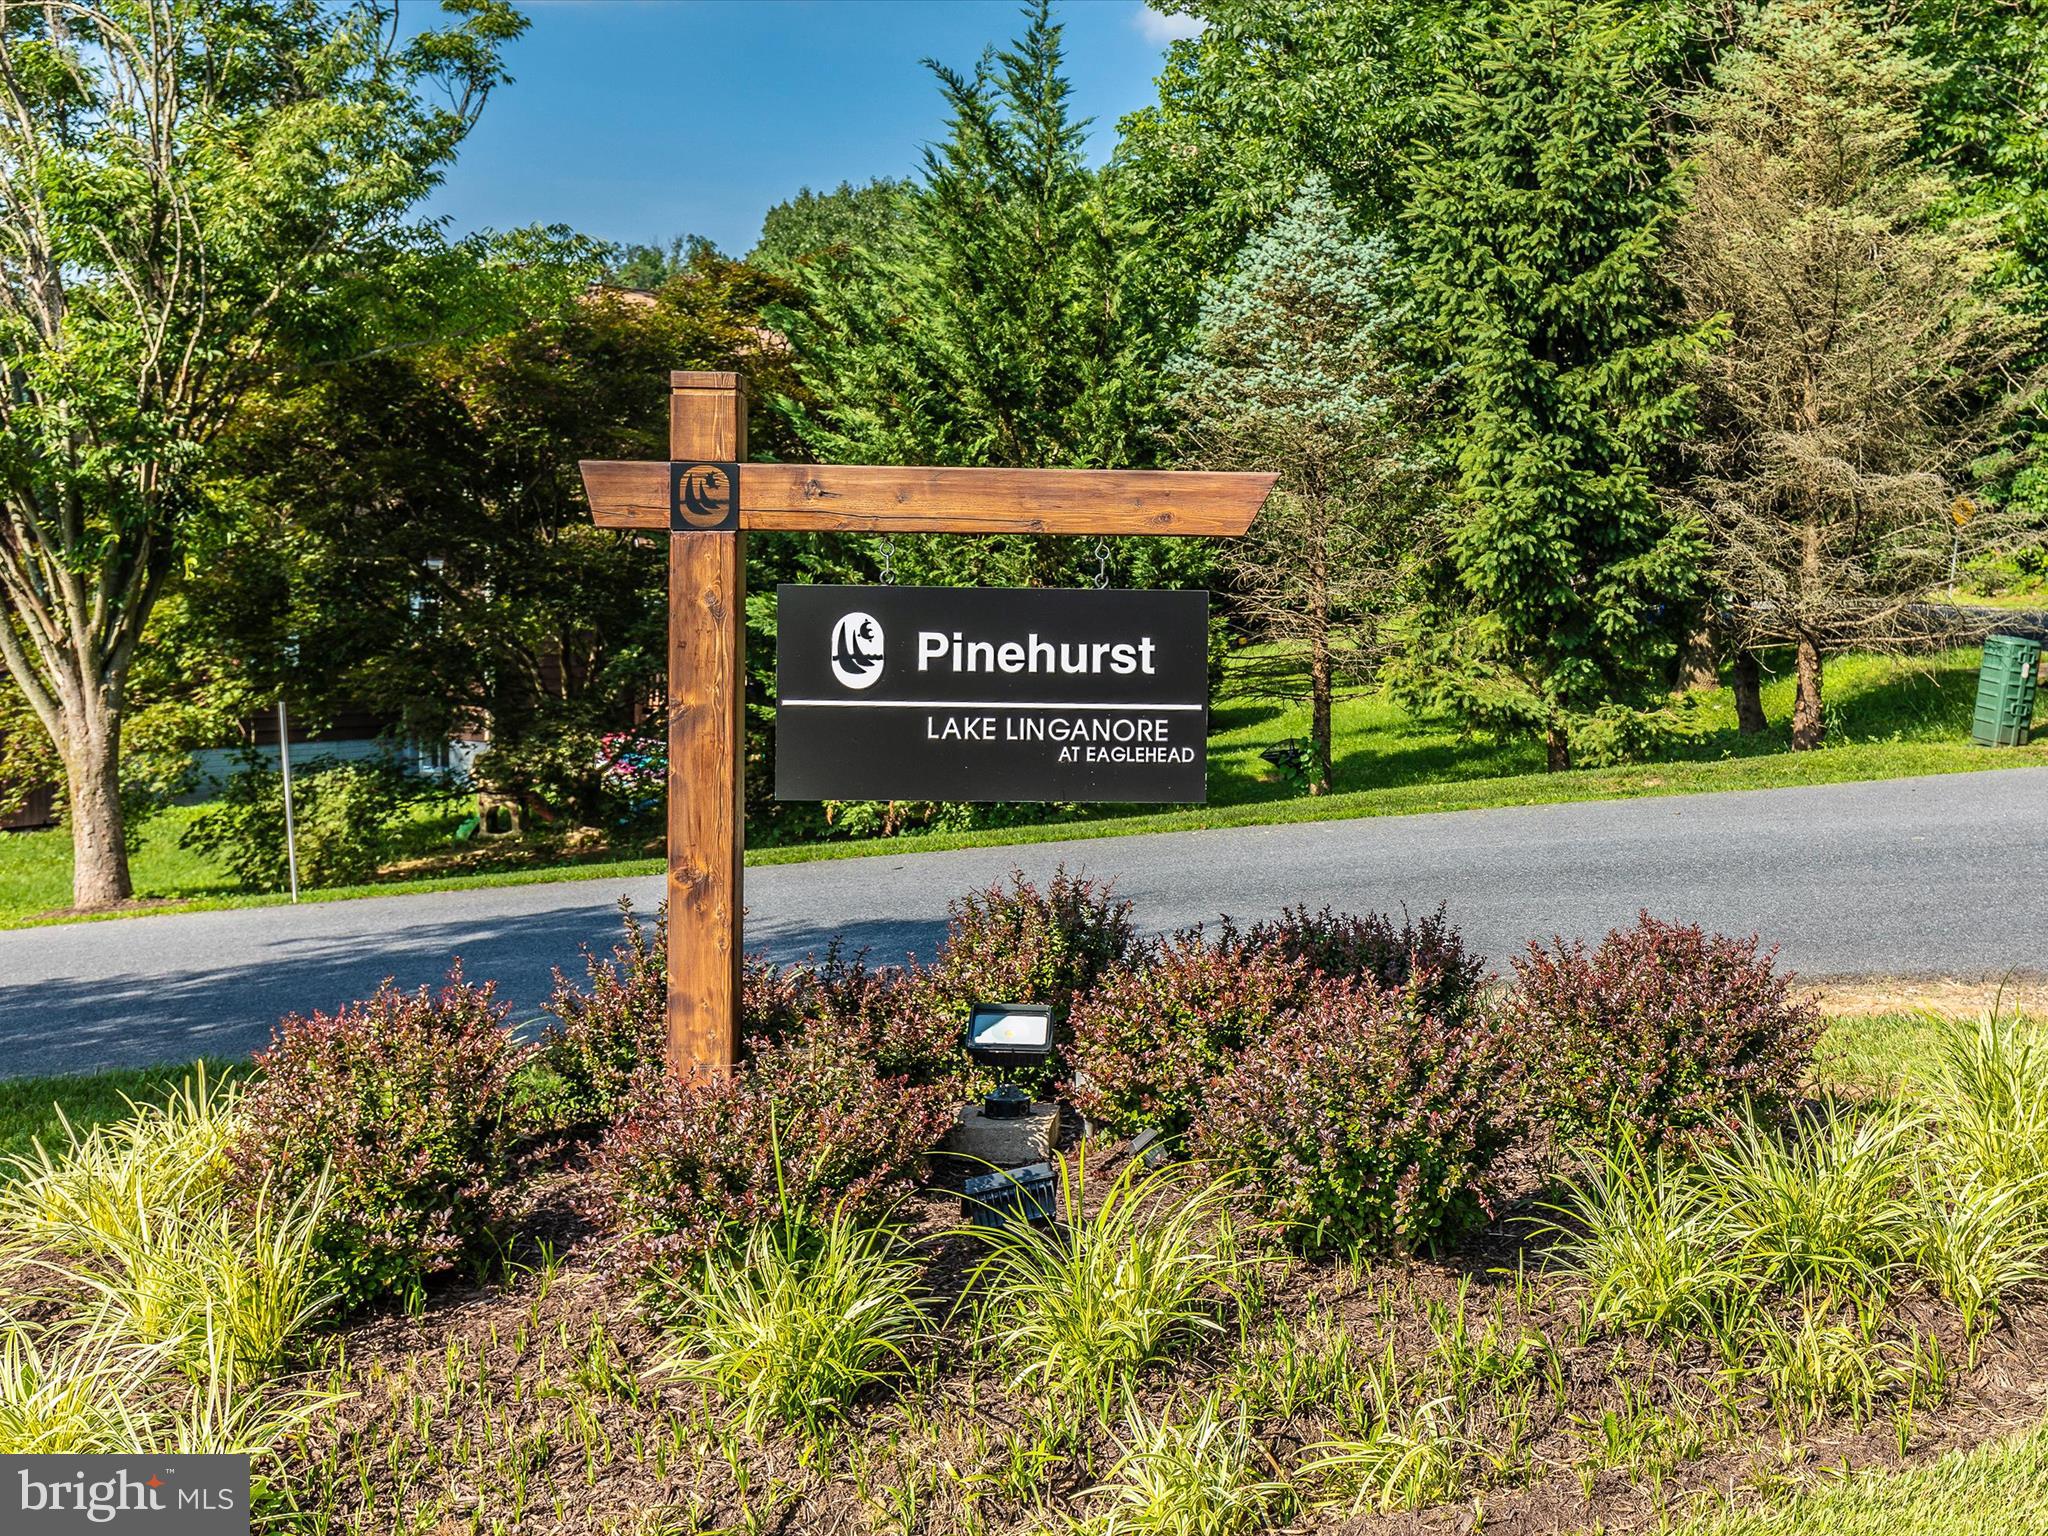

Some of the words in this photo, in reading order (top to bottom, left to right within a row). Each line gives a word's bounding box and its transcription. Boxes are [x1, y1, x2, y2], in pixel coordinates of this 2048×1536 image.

[917, 631, 1156, 675] Pinehurst
[927, 716, 996, 740] LAKE
[1006, 717, 1169, 742] LINGANORE
[1057, 746, 1081, 763] AT
[1086, 746, 1195, 763] EAGLEHEAD
